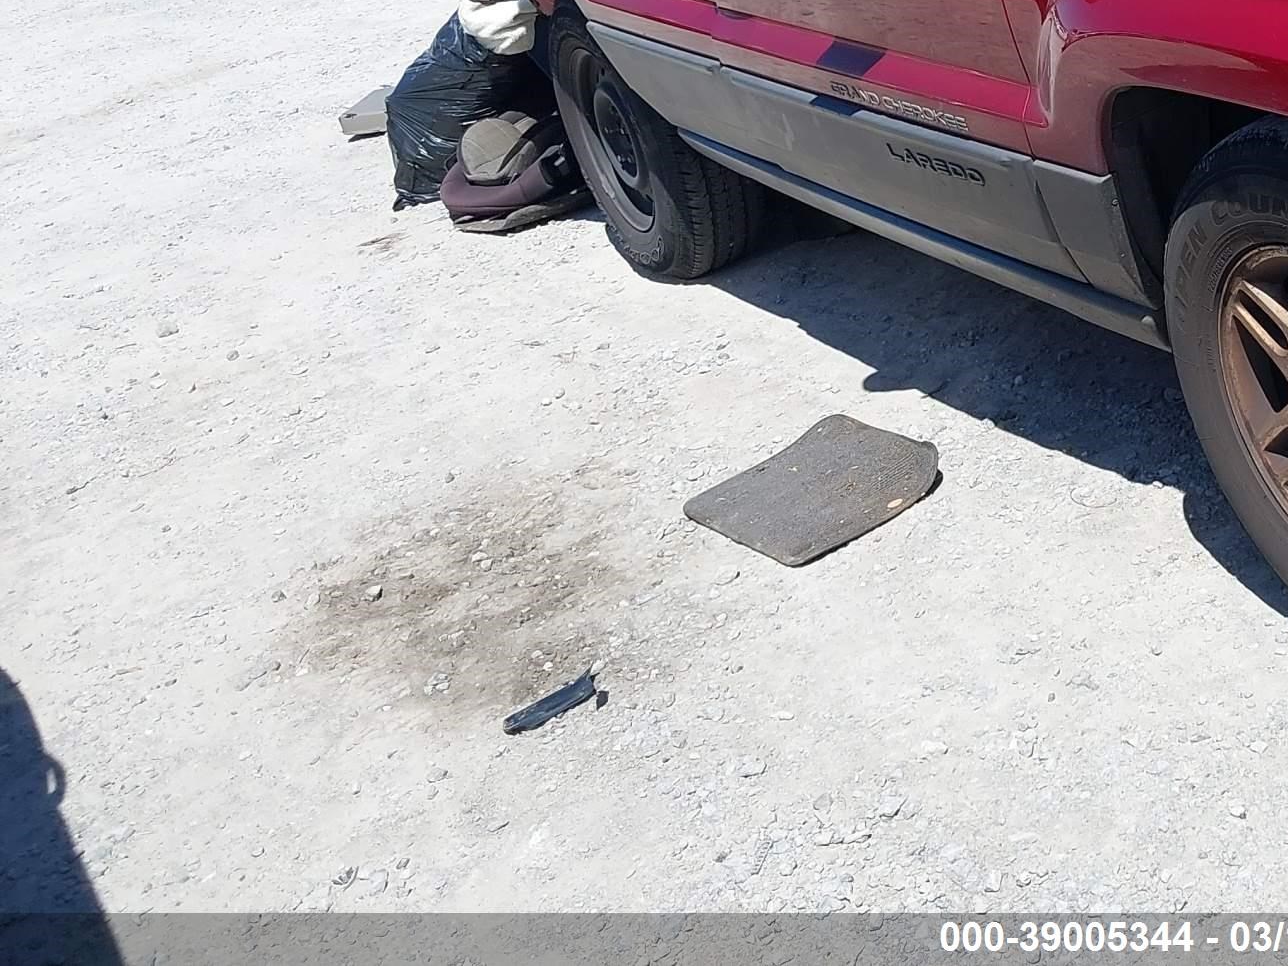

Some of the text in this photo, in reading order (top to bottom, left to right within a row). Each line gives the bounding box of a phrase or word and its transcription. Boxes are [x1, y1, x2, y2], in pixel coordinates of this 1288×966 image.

[830, 80, 969, 132] GRAND CHEROKEE
[885, 142, 986, 187] LAREDO
